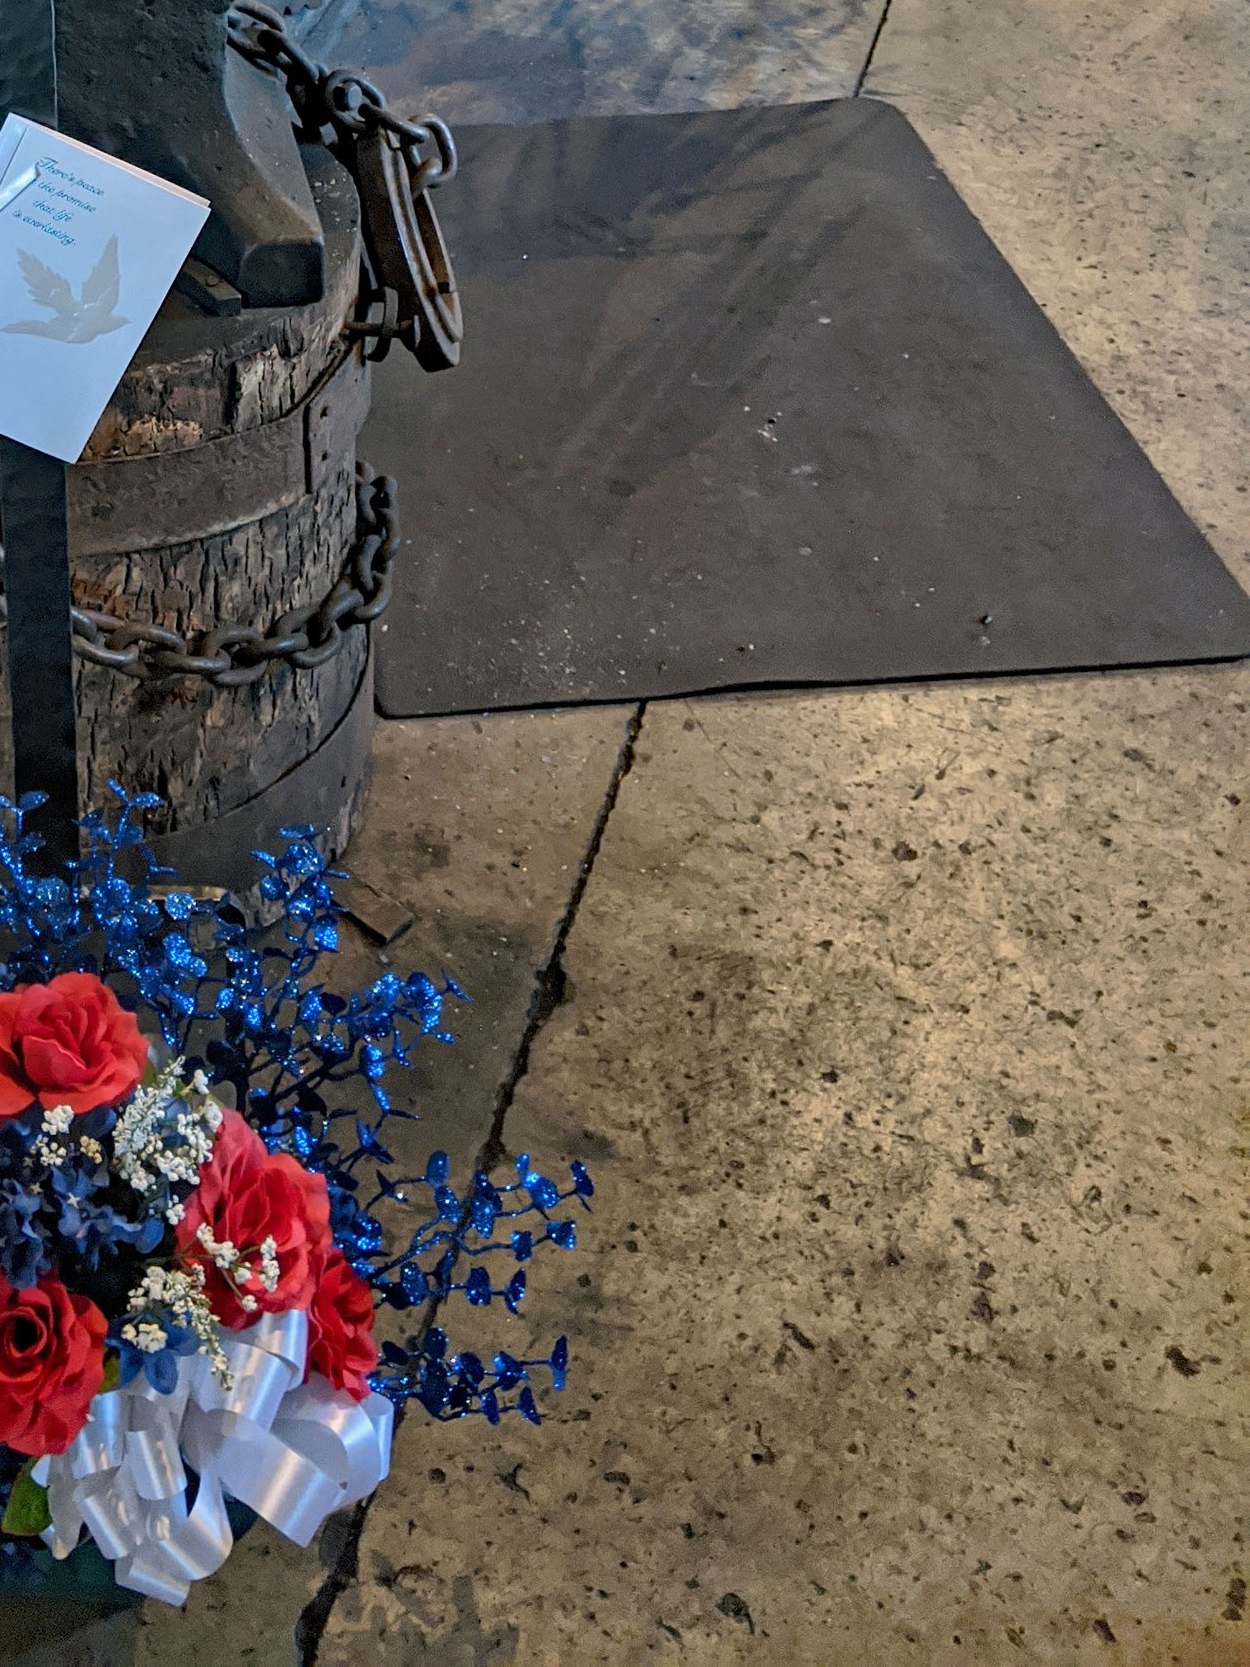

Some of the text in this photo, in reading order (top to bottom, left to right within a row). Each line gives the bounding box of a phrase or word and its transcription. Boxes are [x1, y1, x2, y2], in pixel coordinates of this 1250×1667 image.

[36, 155, 104, 197] There's peace
[32, 199, 75, 222] that life
[37, 180, 56, 194] the
[49, 189, 97, 213] promise
[12, 207, 77, 246] is everlasting.
